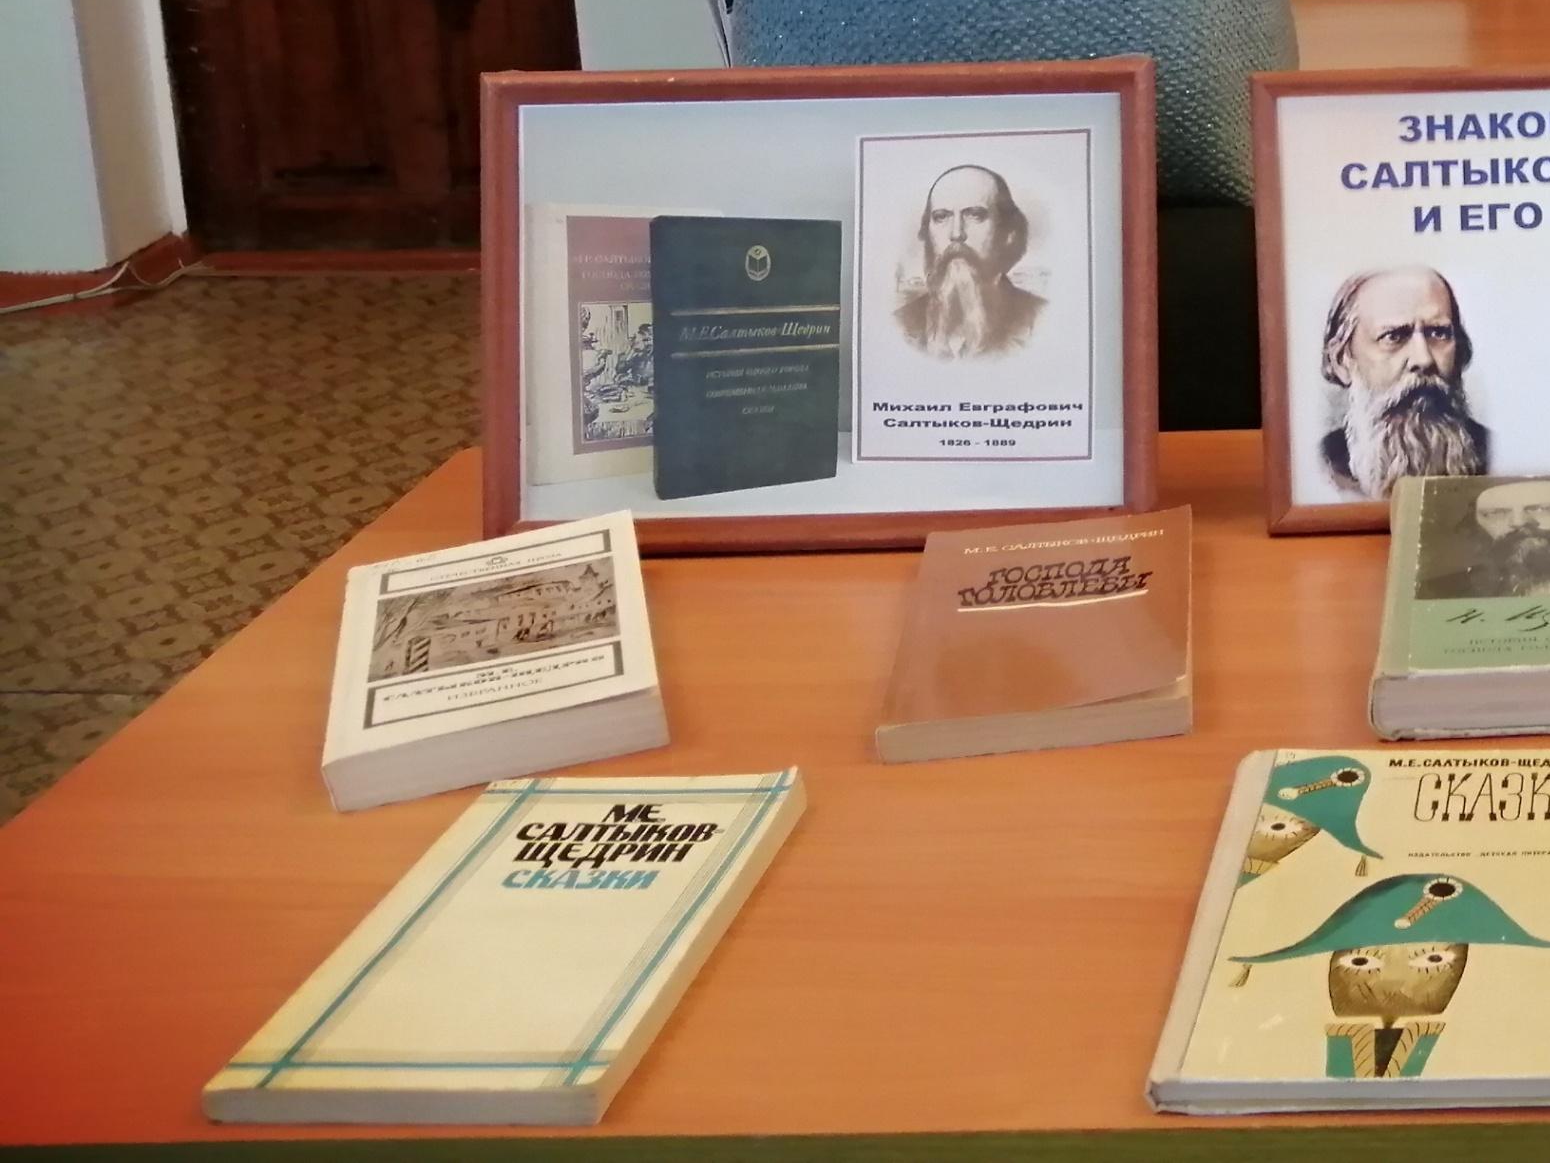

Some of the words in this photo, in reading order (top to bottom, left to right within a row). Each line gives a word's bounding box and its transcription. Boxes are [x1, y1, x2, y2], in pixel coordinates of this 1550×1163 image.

[1413, 206, 1443, 233] И
[1460, 201, 1544, 232] ЕГО
[872, 401, 952, 413] Михаил
[958, 401, 1084, 414] Евграфович
[883, 417, 1073, 430] Салтыков-Щедрин
[939, 439, 971, 447] 1826
[985, 439, 1017, 447] 1889
[987, 555, 1133, 589] ГОСПОДА
[957, 571, 1154, 607] ГОЛОВЛЕВЫ
[515, 822, 726, 844] САЛТЫКОВ-
[512, 841, 696, 870] ЩЕДРИН
[500, 869, 662, 890] СКАЗКИ
